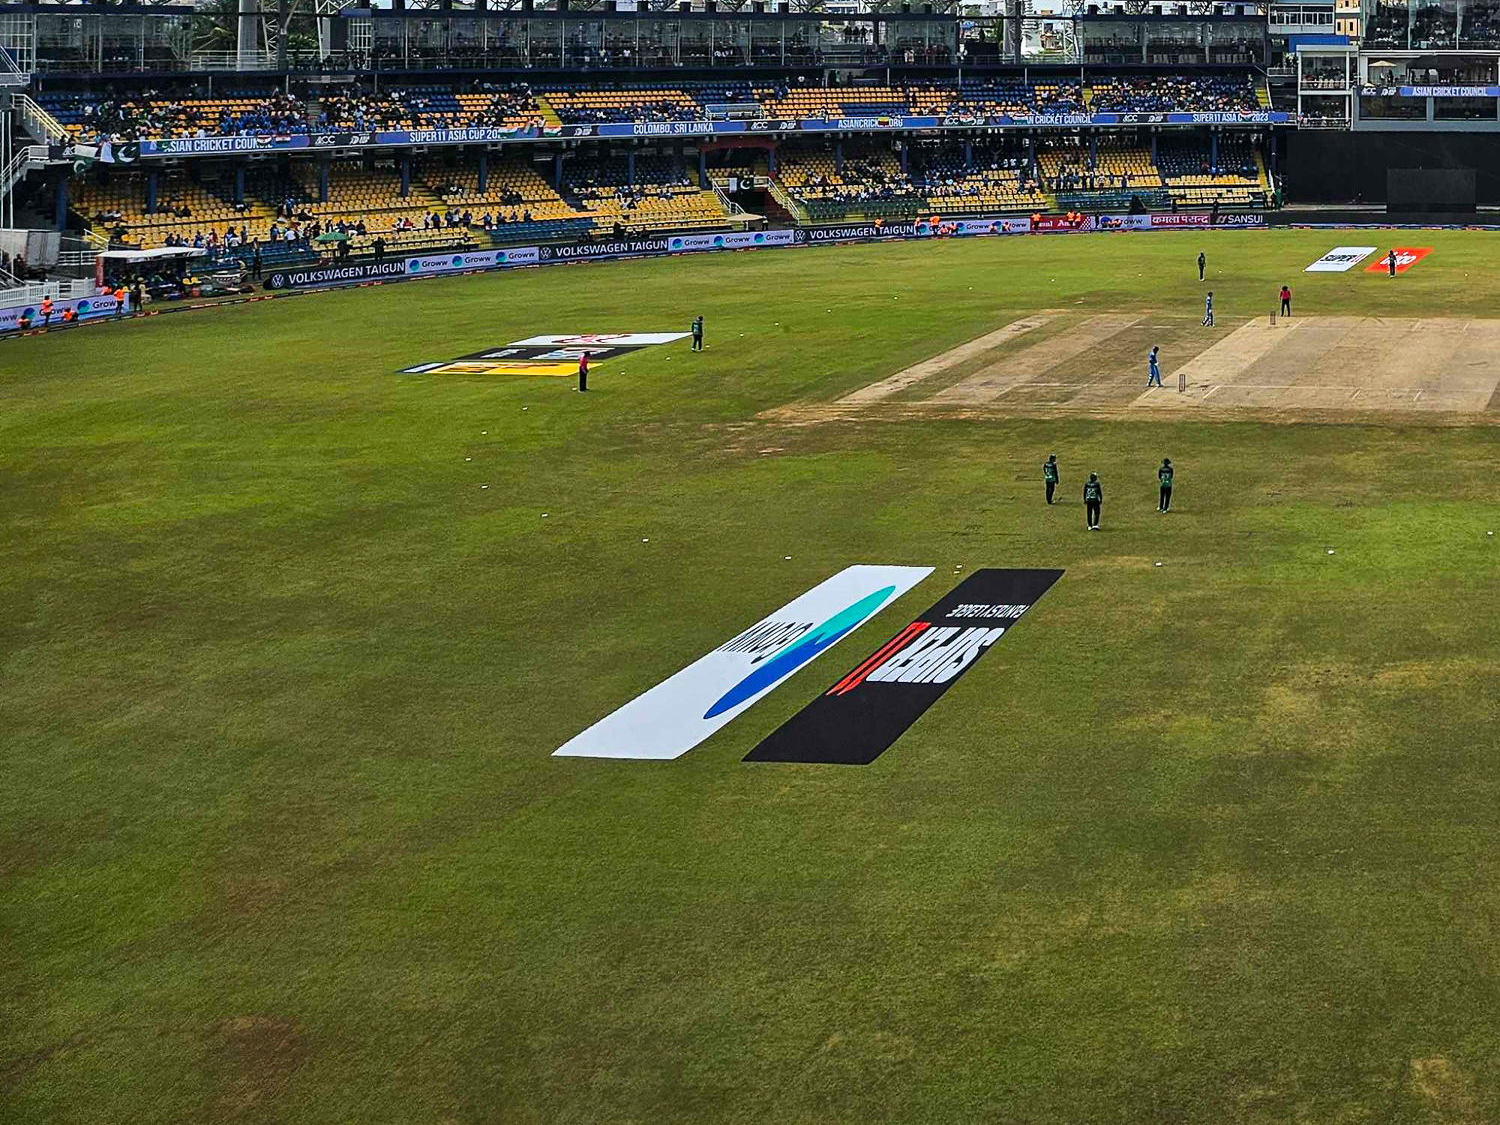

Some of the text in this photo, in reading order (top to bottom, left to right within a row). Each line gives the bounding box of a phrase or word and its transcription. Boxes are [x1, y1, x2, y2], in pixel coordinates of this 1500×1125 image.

[1412, 87, 1487, 96] ASIAN CRICKET COUNCIL
[1036, 114, 1063, 124] CRICKET
[1064, 114, 1092, 124] COUNCIL
[1221, 113, 1236, 122] ASIA
[633, 123, 714, 136] COLOMBO, SRI LANKA
[410, 129, 485, 142] SUPER11 ASIA CUP
[194, 139, 234, 152] CRICKET
[1152, 214, 1179, 224] कमला
[1228, 215, 1264, 224] SANSUI
[810, 224, 913, 240] VOLKSWAGEN TAIGUN
[725, 235, 750, 244] Groww
[765, 233, 790, 241] Groww
[684, 238, 710, 247] Groww
[556, 239, 668, 258] VOLKSWAGEN TAIGUN
[464, 255, 492, 264] Groww
[508, 251, 535, 260] Groww
[421, 259, 448, 268] Groww
[289, 262, 405, 285] VOLKSWAGEN TAIGUN
